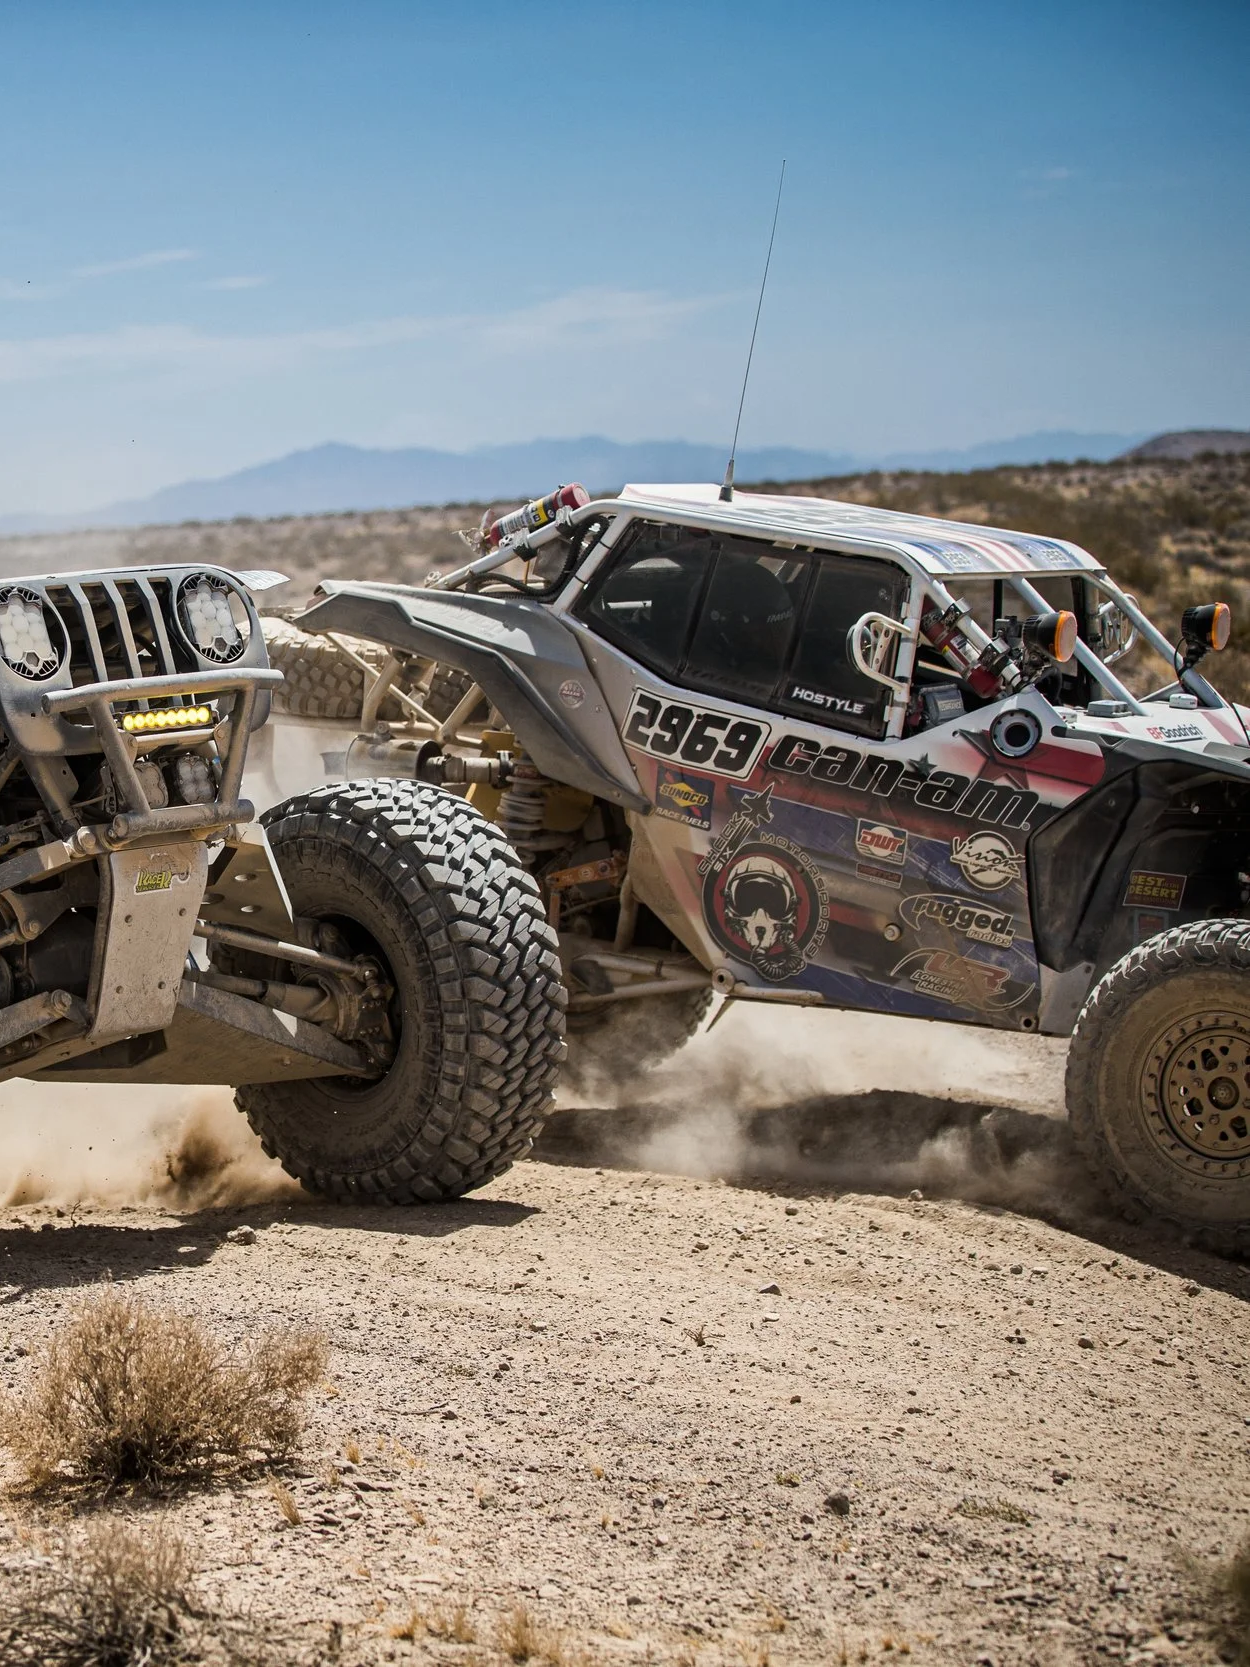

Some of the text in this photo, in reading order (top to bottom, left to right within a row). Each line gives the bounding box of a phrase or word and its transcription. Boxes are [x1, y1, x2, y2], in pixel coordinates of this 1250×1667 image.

[791, 686, 866, 714] HOSTYLE
[625, 693, 763, 772] 2969
[1146, 723, 1204, 740] BFGoodrich
[659, 783, 709, 806] SUNOCO
[655, 807, 710, 829] RACE FUELS
[697, 811, 744, 876] CHECK
[713, 848, 734, 873] SIX
[1128, 885, 1179, 899] DESERT
[1131, 875, 1166, 887] BEST
[759, 831, 831, 960] MOTORSPORTS
[967, 929, 1012, 947] radios
